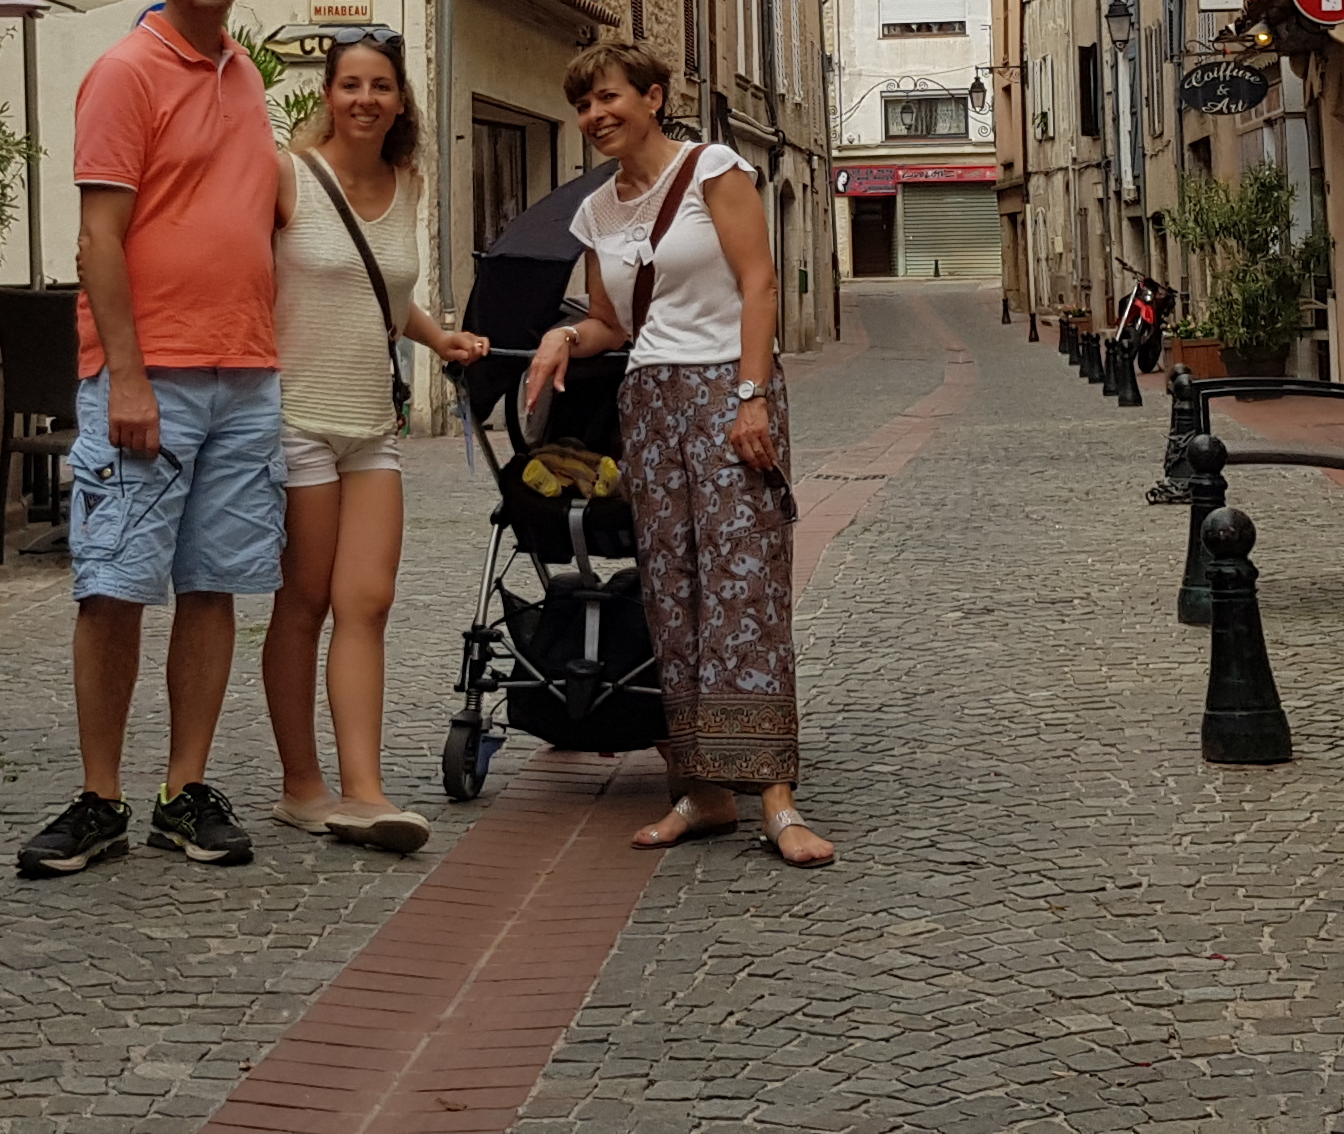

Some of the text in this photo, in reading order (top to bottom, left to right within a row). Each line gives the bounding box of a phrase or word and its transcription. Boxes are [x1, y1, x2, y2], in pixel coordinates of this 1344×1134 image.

[314, 6, 368, 16] MIRABEAU
[1184, 62, 1263, 89] Coiffure
[1217, 84, 1230, 96] &
[1202, 97, 1246, 114] Art
